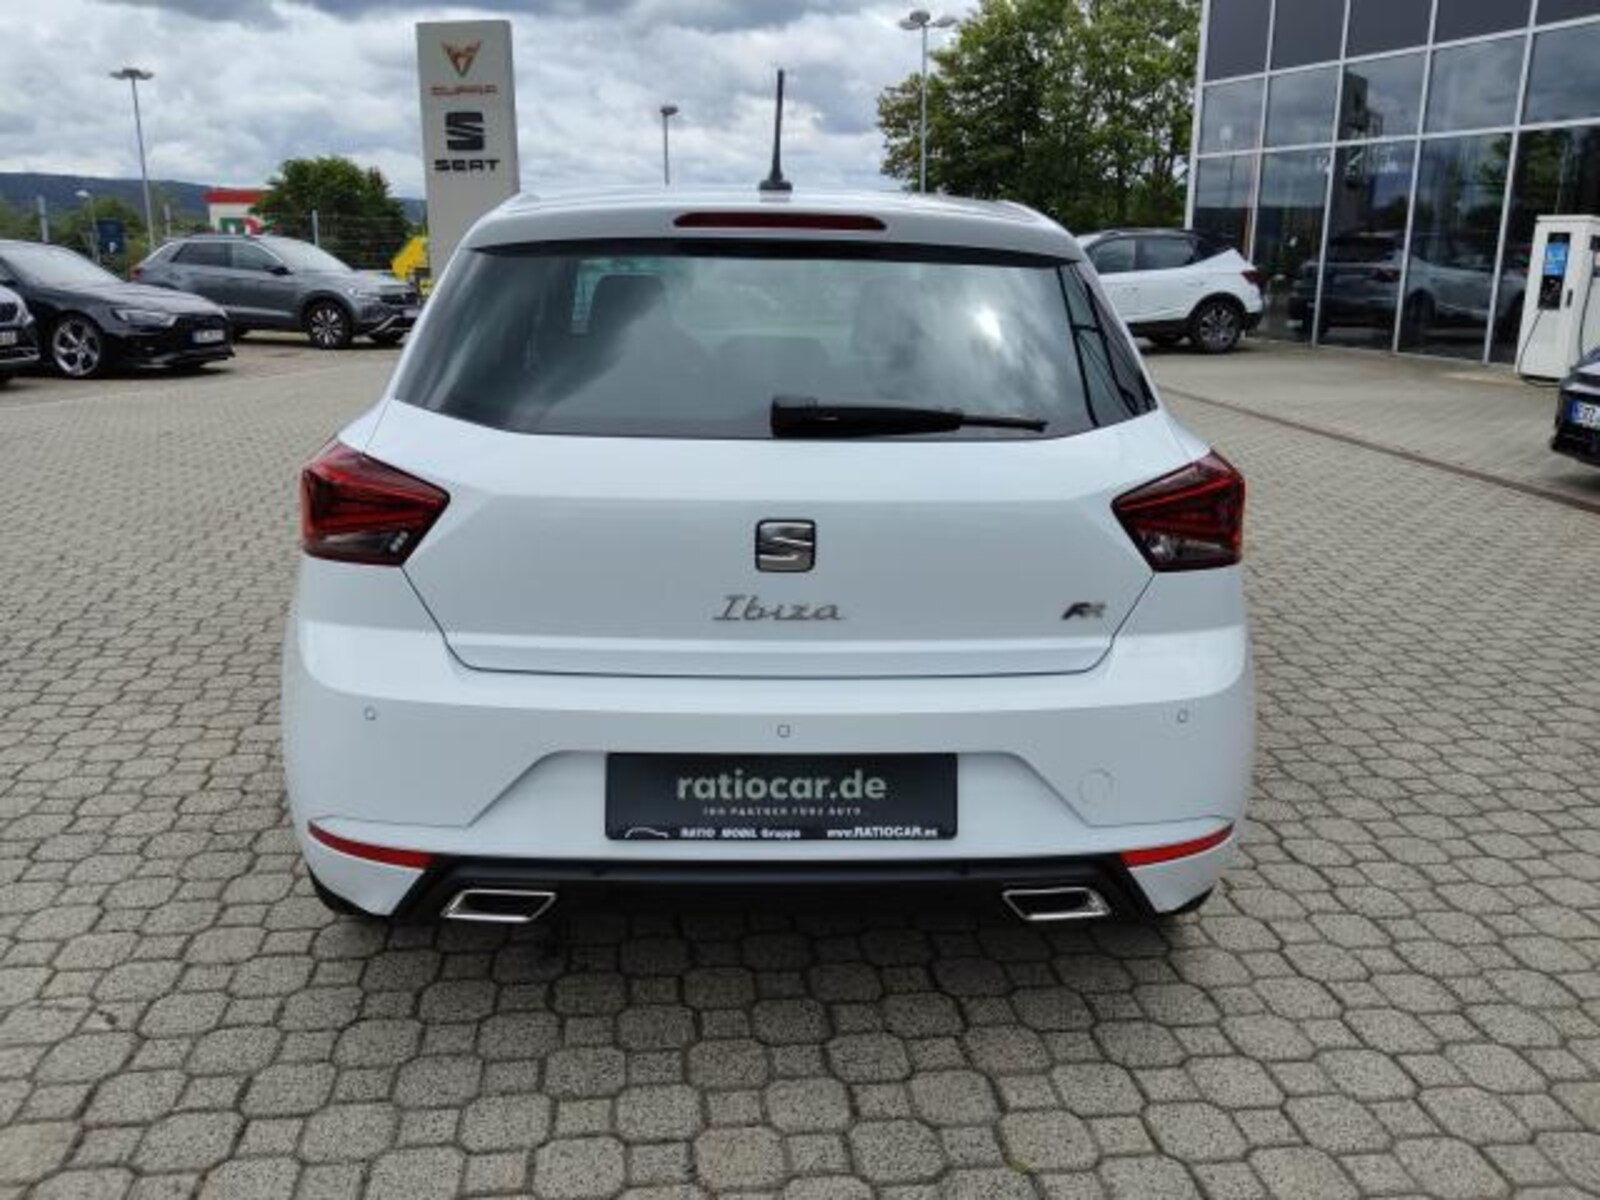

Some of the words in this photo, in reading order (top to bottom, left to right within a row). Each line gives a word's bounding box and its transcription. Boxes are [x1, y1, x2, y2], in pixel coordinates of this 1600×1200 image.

[433, 159, 500, 172] SEAT
[712, 594, 845, 621] Ibiza
[677, 769, 887, 800] ratiocar.de
